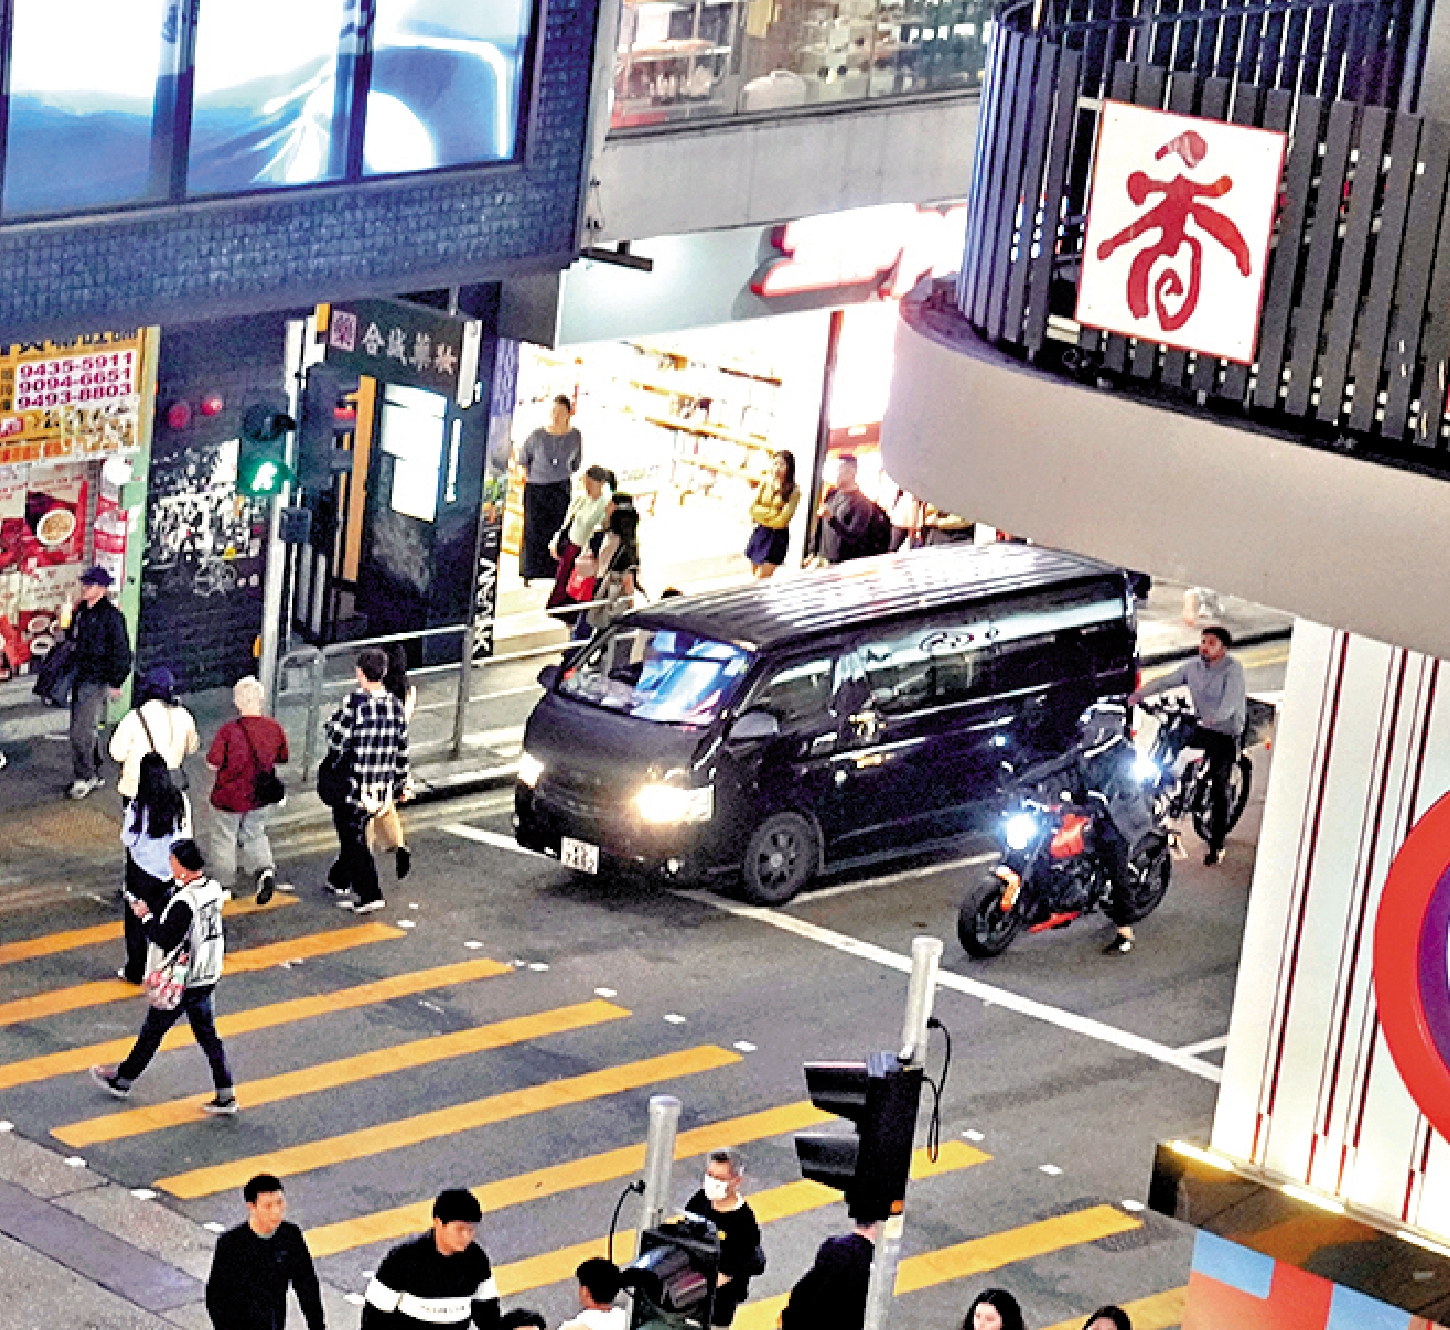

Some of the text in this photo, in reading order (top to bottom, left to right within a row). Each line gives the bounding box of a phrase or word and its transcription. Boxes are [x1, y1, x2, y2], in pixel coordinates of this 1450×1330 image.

[20, 351, 133, 377] 9435-5911
[18, 367, 131, 393] 9094-6651
[17, 382, 132, 410] 9493-8803
